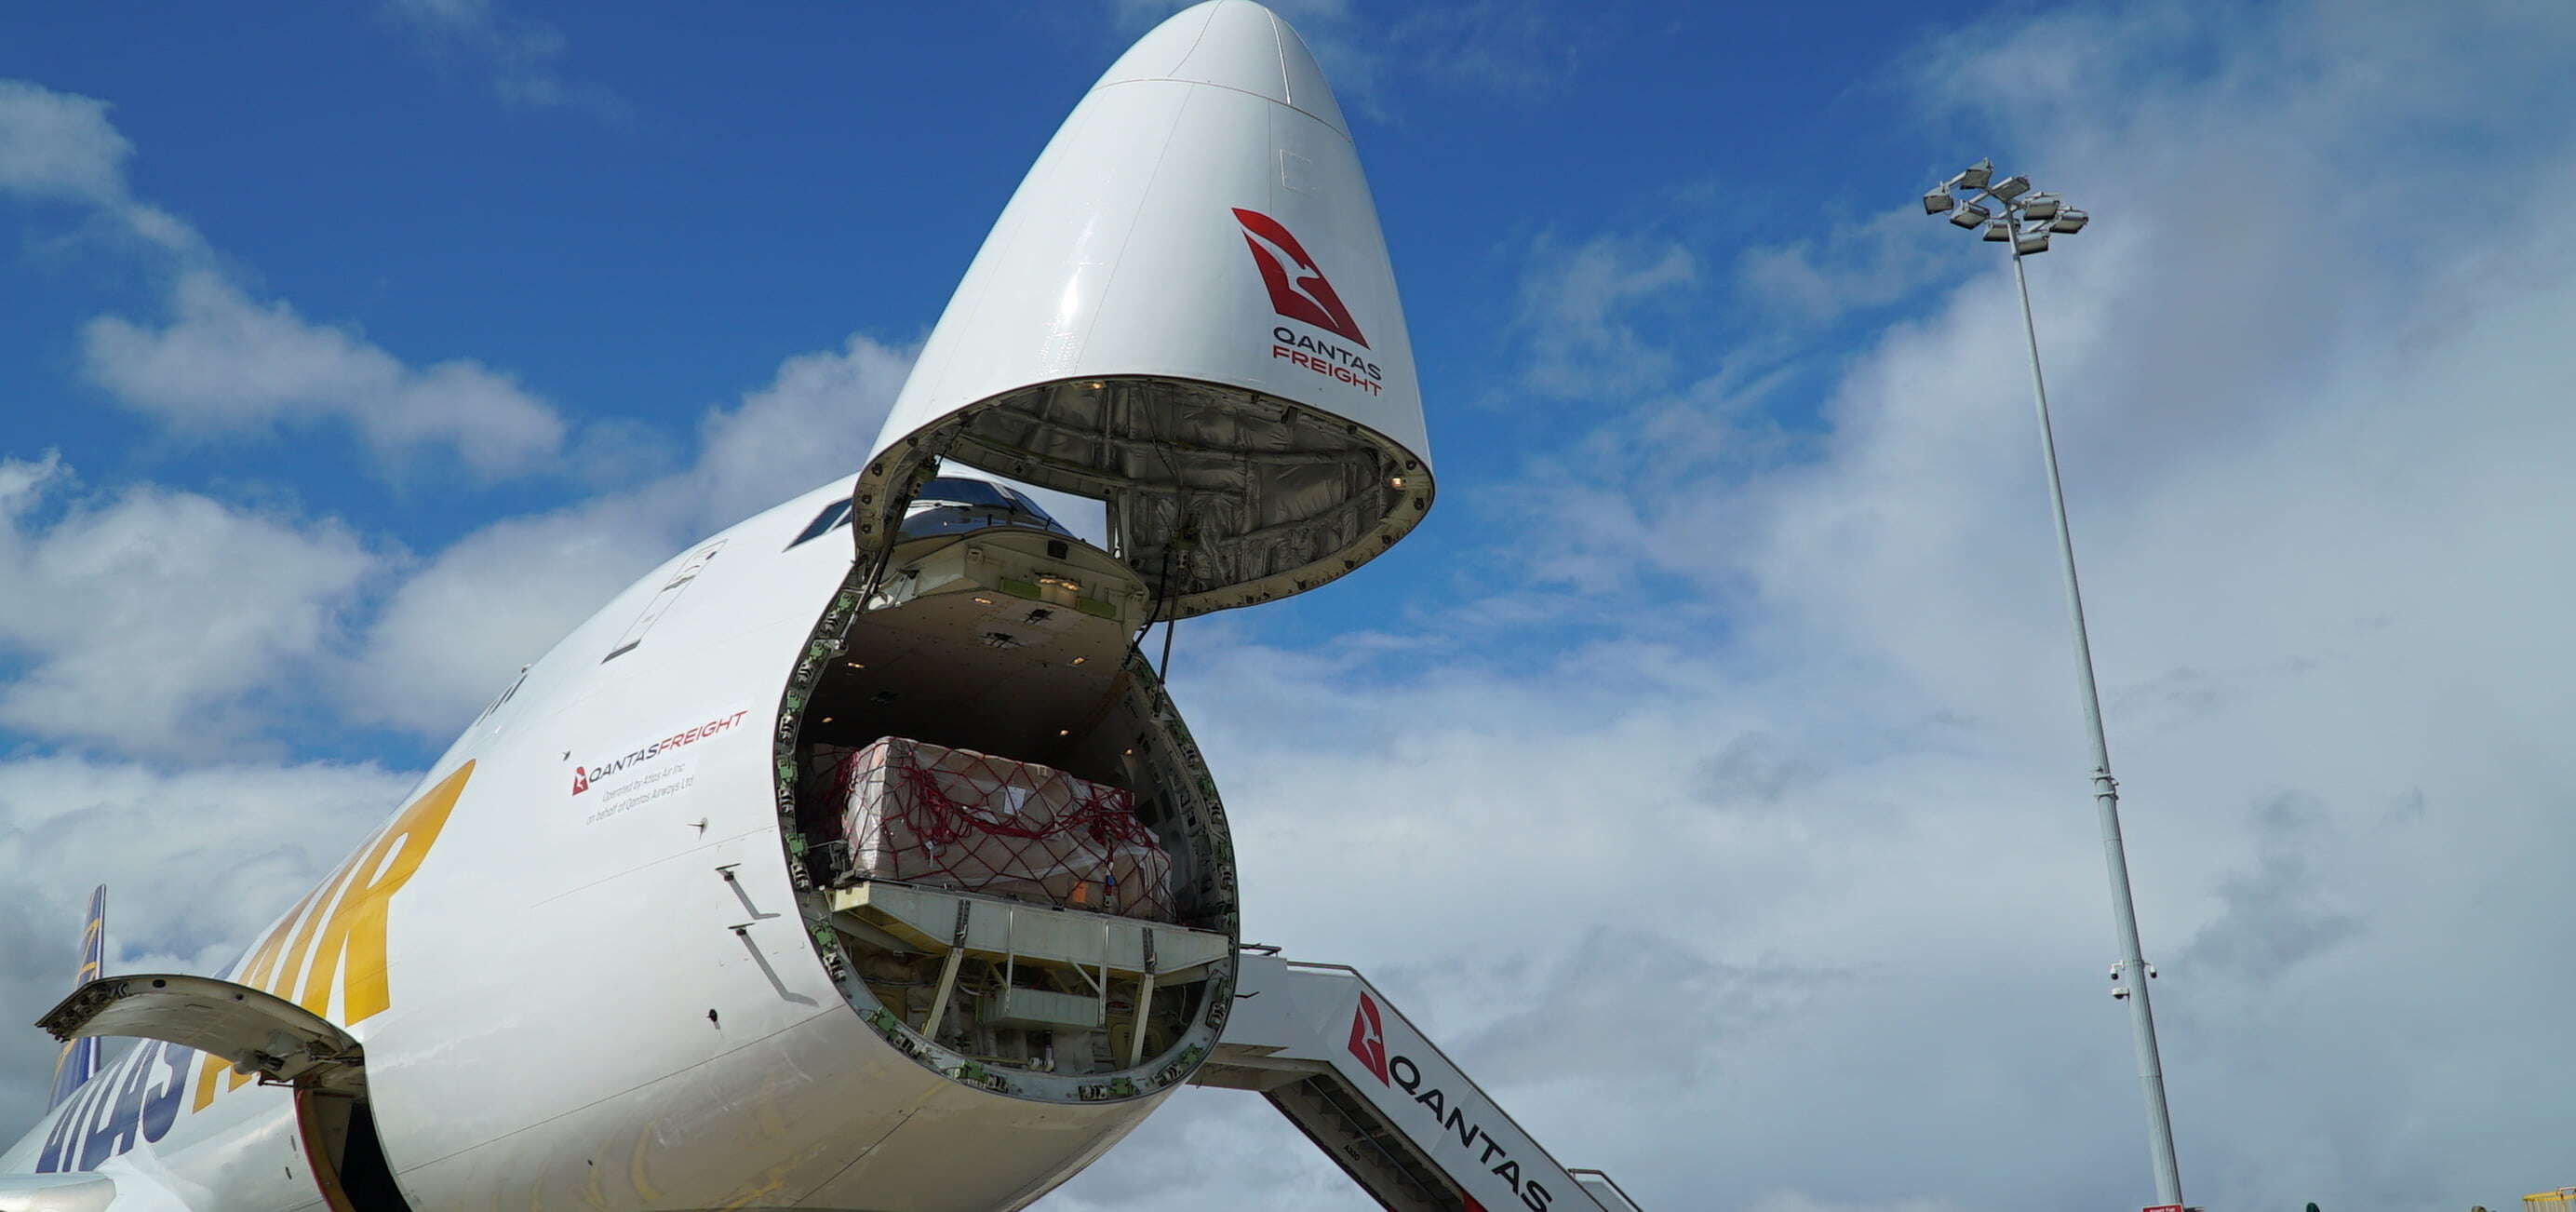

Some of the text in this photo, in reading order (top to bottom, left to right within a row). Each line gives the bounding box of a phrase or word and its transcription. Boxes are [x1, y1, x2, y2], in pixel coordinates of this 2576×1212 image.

[1272, 344, 1382, 397] FREIGHT
[1273, 327, 1382, 381] QANTAS
[1389, 1056, 1553, 1212] QANTAS
